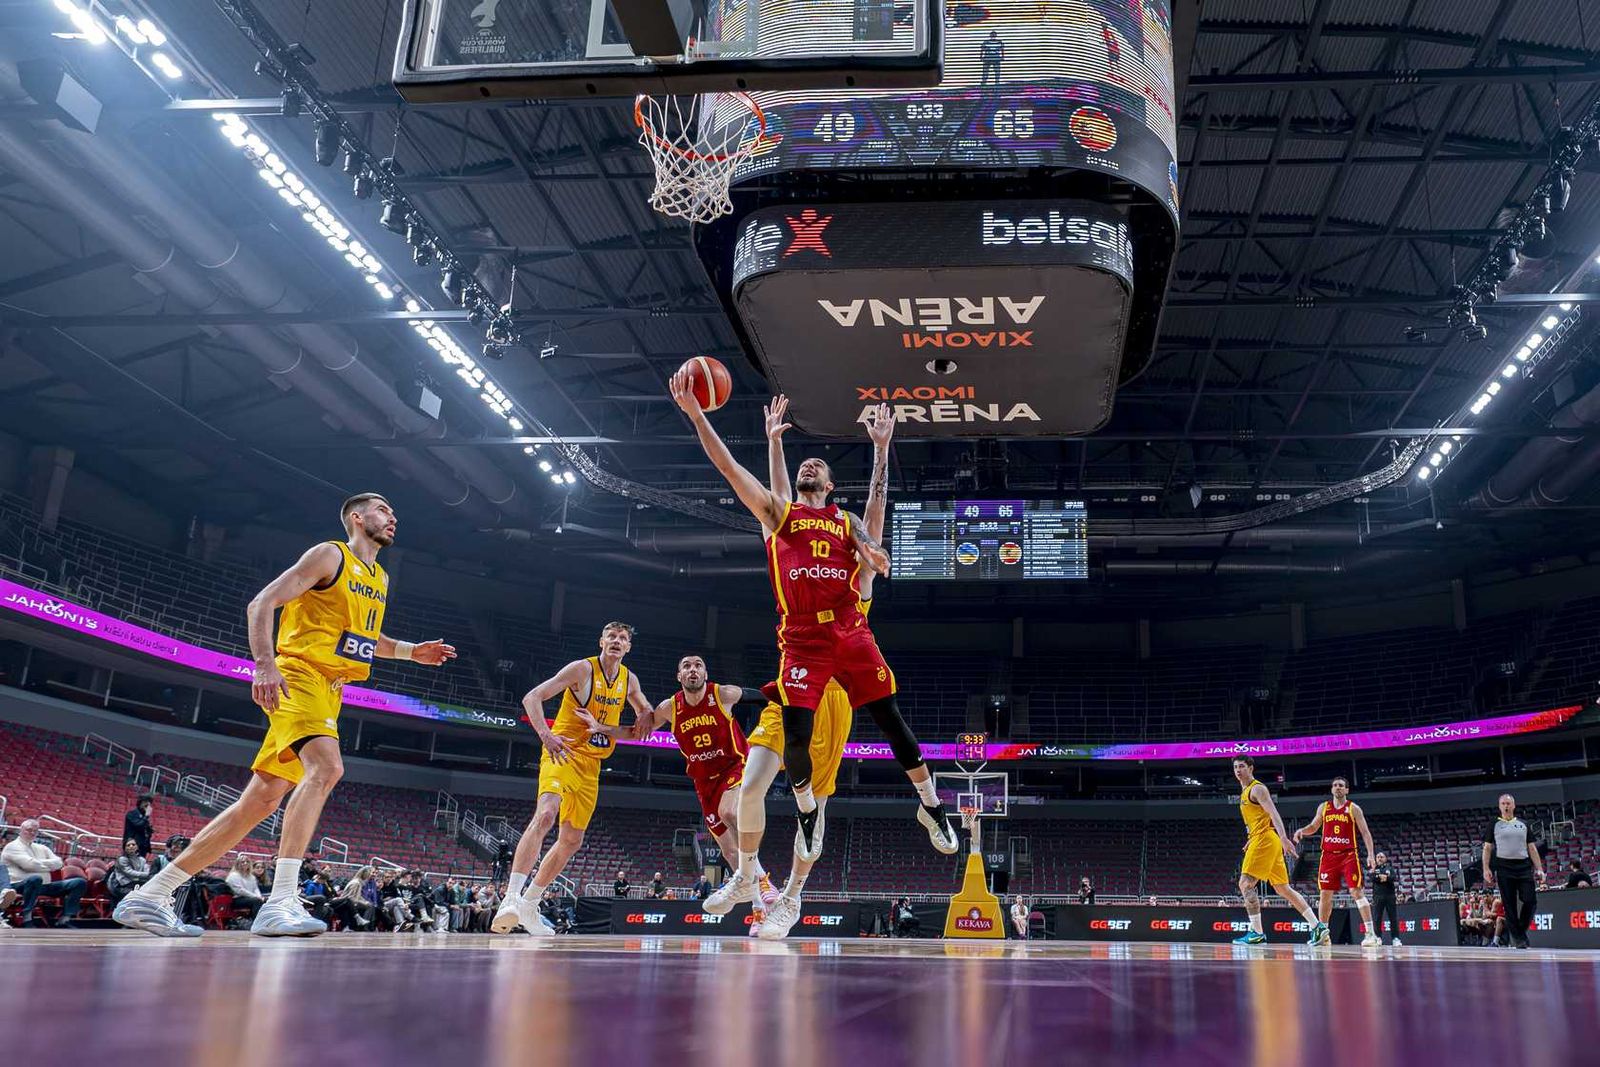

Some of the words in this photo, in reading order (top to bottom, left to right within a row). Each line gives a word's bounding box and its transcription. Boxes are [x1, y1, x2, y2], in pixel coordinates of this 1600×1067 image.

[906, 104, 943, 119] 9:33
[813, 113, 855, 141] 49
[994, 110, 1034, 138] 65
[902, 330, 1033, 348] XIAOMI
[856, 385, 976, 400] XIAOMI
[964, 505, 979, 518] 49
[999, 505, 1013, 517] 65
[790, 518, 843, 540] ESPAÑA
[809, 540, 831, 558] 10
[789, 564, 848, 580] endesa
[365, 608, 377, 631] 11
[680, 714, 718, 733] ESPAÑA
[693, 733, 712, 748] 29
[964, 735, 984, 745] 9:33
[689, 749, 725, 762] endesa
[1333, 825, 1341, 834] 6
[704, 848, 722, 858] 107
[987, 854, 1005, 863] 108
[626, 914, 666, 924] GGBET
[684, 914, 724, 924] GGBET
[803, 915, 843, 926] GGBET
[1090, 920, 1131, 930] GGBET
[1150, 920, 1193, 930] GGBET
[1421, 918, 1440, 930] GGBET
[1570, 911, 1600, 928] GGBE
